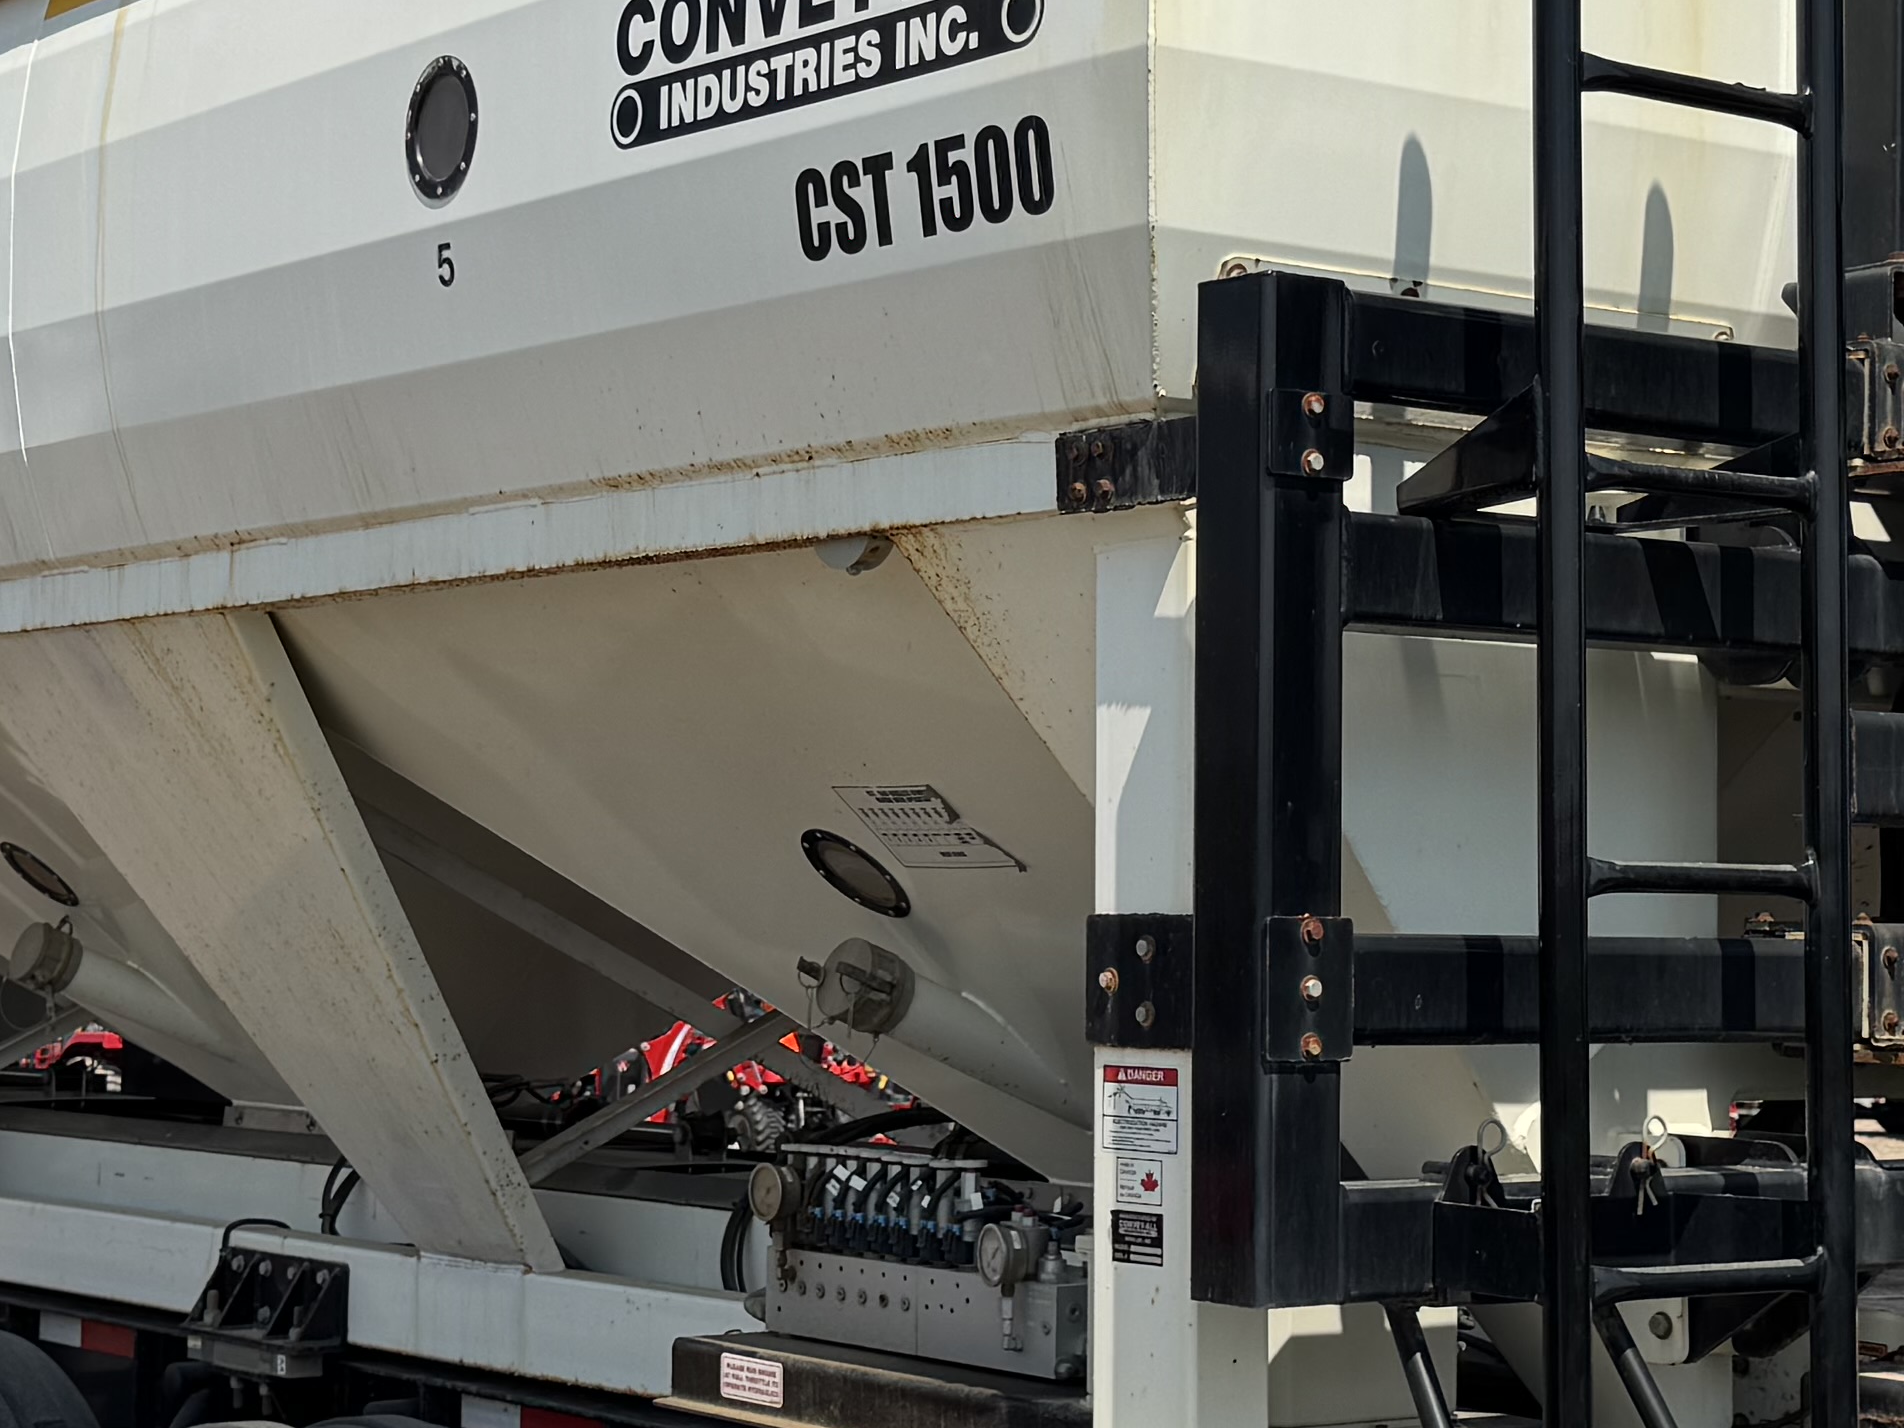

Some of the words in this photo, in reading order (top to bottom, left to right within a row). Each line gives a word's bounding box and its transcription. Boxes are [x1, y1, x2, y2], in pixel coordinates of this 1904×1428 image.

[658, 29, 882, 132] INDUSTRIES
[895, 4, 979, 70] INC.
[796, 150, 895, 262] CST
[906, 114, 1054, 238] 1500
[438, 242, 455, 287] 5
[1126, 1069, 1164, 1081] DANGER
